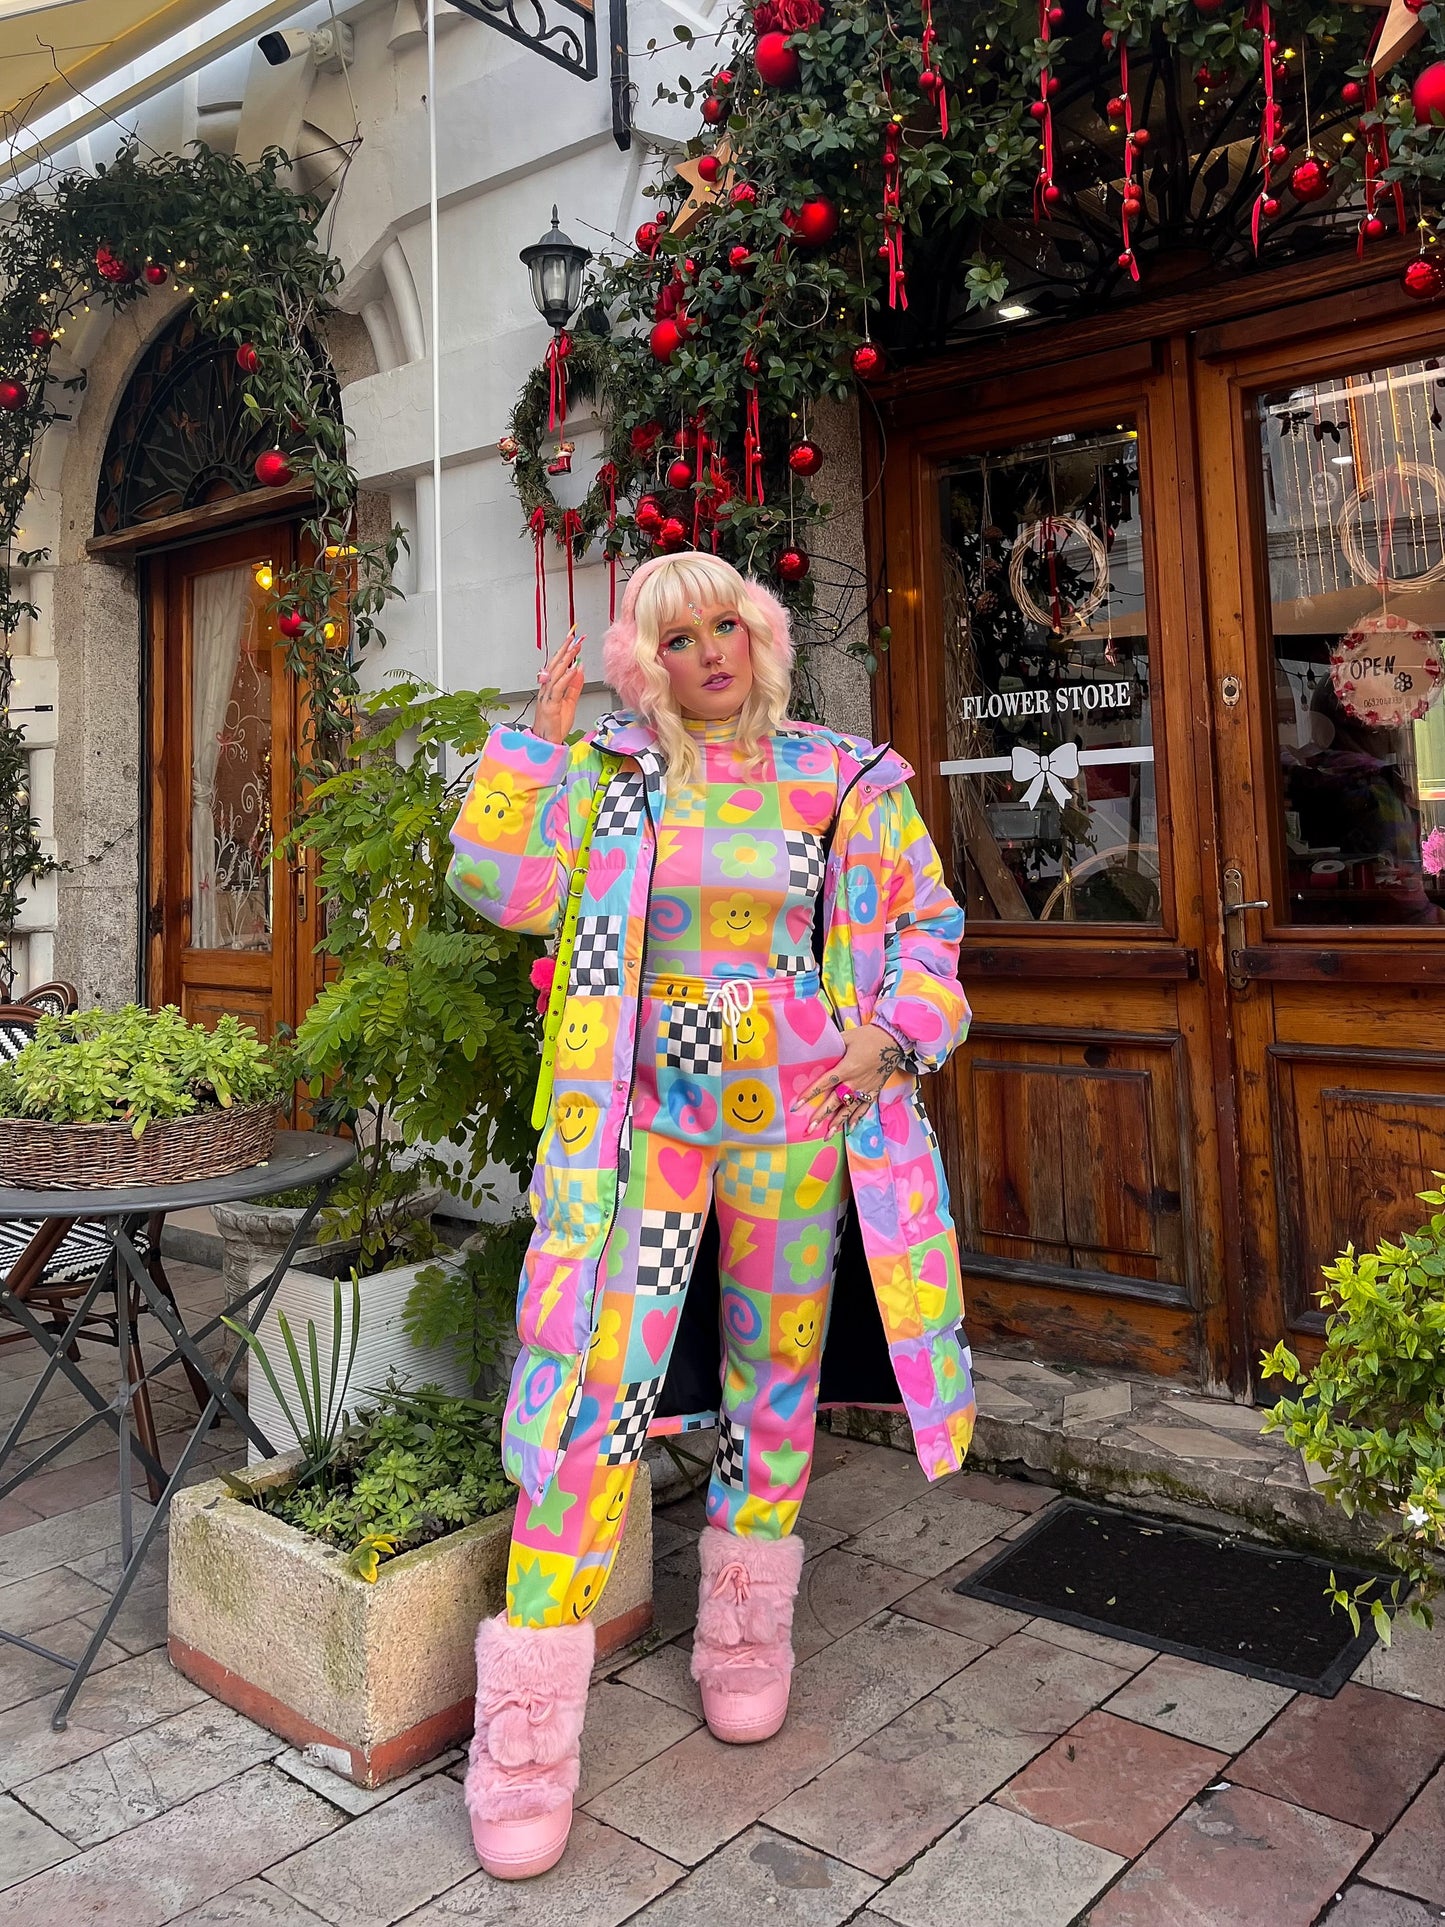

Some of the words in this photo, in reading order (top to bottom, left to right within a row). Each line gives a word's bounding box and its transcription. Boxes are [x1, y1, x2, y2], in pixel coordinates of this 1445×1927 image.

[1350, 655, 1395, 680] OPEN
[961, 689, 1050, 720] FLOWER
[1055, 682, 1131, 712] STORE
